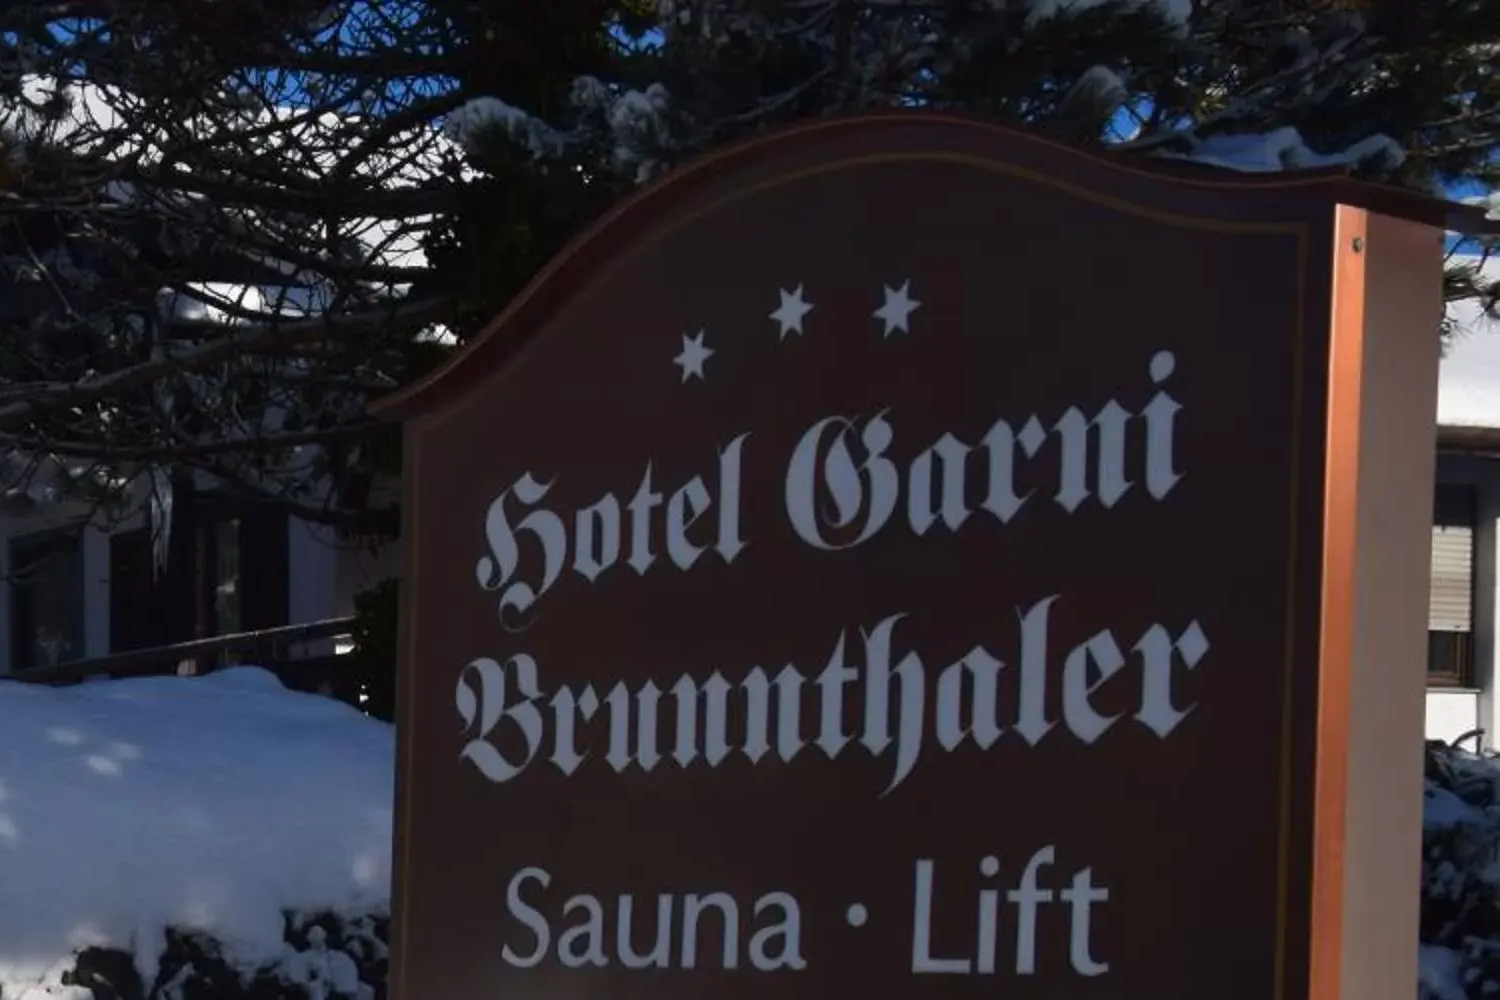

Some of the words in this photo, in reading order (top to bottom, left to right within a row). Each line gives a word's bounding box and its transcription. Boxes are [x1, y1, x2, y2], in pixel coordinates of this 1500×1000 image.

[476, 432, 752, 632] Hotel
[785, 350, 1188, 550] Garni
[455, 594, 1211, 799] Brunnthaler
[501, 867, 807, 972] Sauna
[911, 845, 1109, 976] Lift
